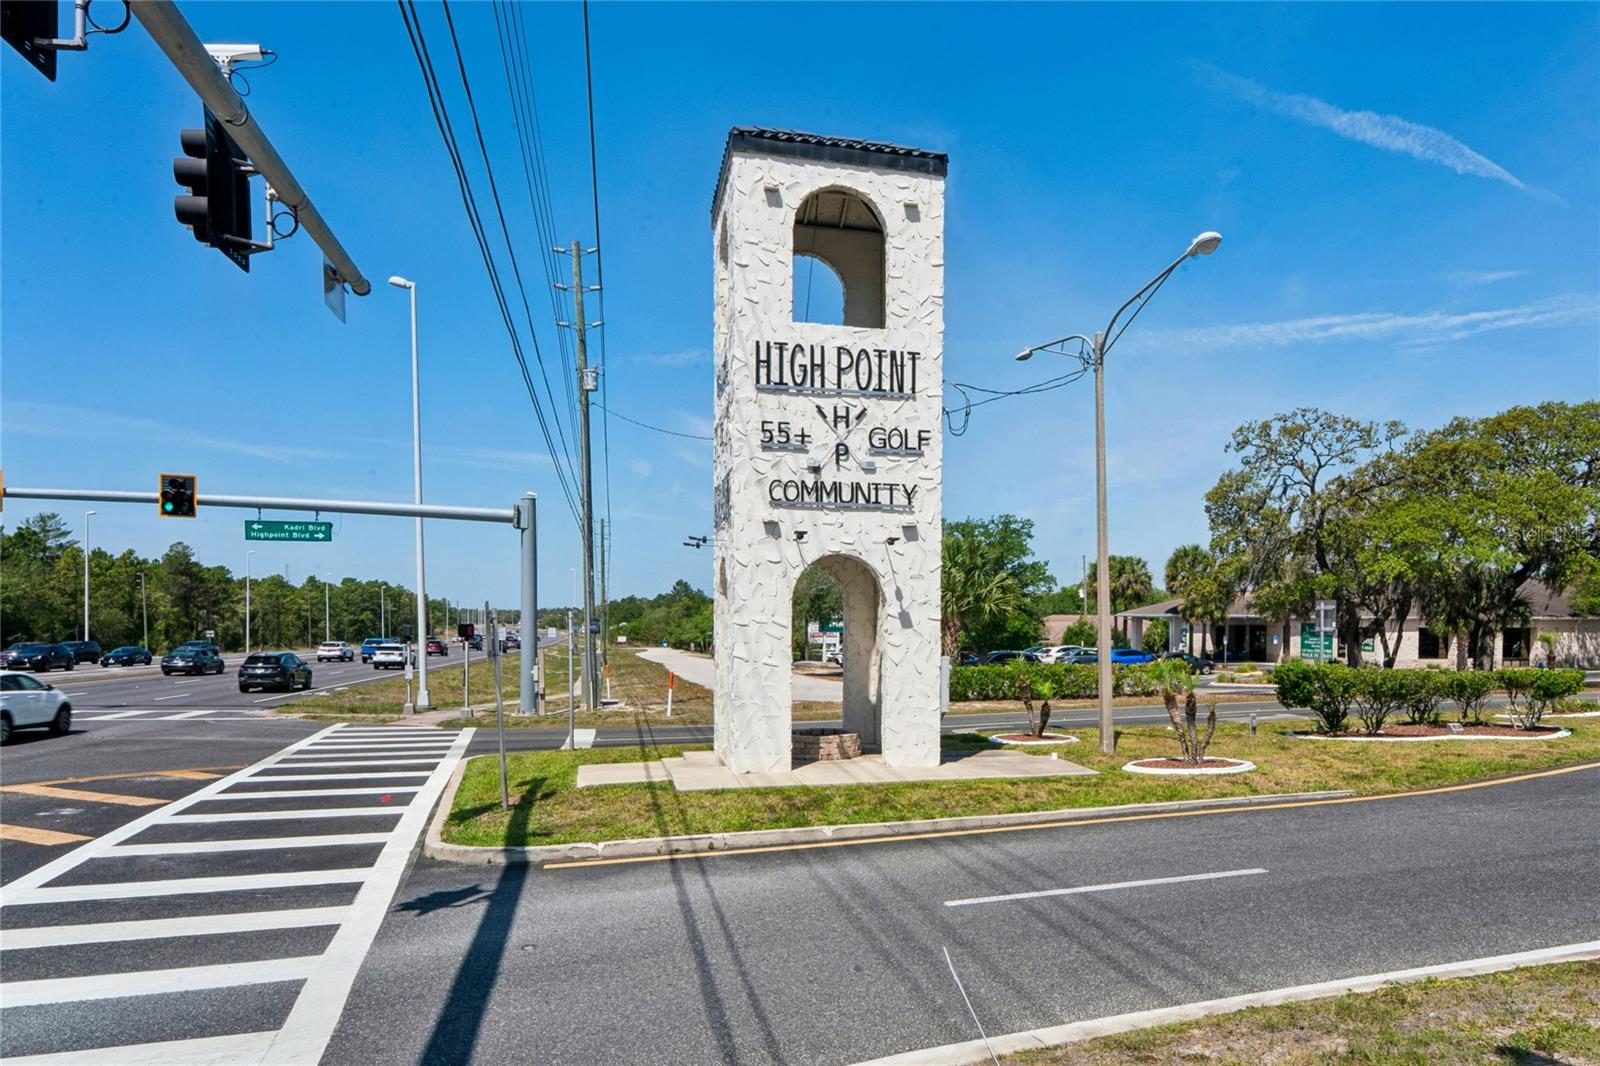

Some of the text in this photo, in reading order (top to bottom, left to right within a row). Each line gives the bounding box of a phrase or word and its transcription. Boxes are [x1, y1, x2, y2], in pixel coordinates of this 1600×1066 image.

[755, 340, 921, 395] HIGH POINT
[833, 406, 850, 429] H
[760, 420, 931, 451] 55+ GOLF
[835, 442, 849, 466] P
[768, 479, 918, 506] COMMUNITY
[251, 531, 310, 539] Highpoint Blvd
